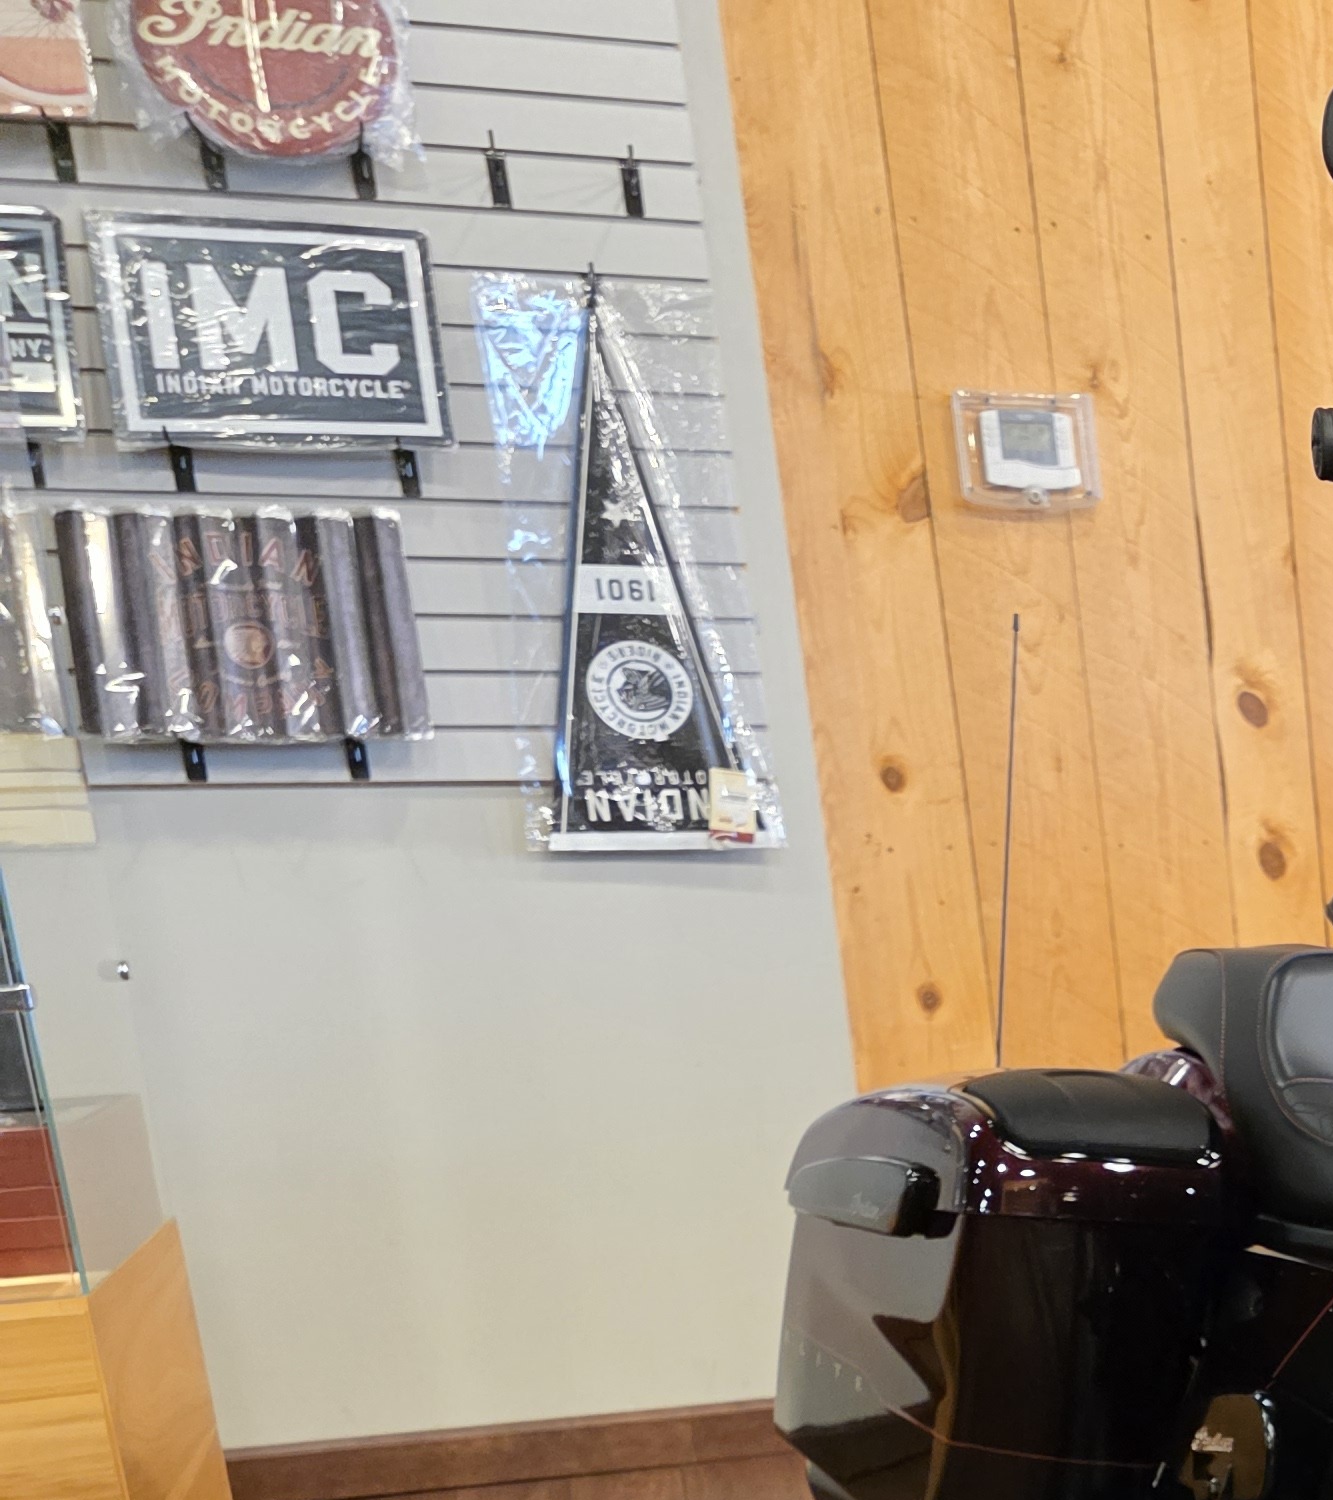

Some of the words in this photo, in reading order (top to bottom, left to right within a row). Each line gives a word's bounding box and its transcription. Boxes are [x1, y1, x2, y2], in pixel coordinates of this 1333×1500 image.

[138, 0, 382, 58] Indian
[138, 258, 401, 377] IMC
[594, 577, 655, 602] 1901
[584, 788, 709, 822] NDIAN
